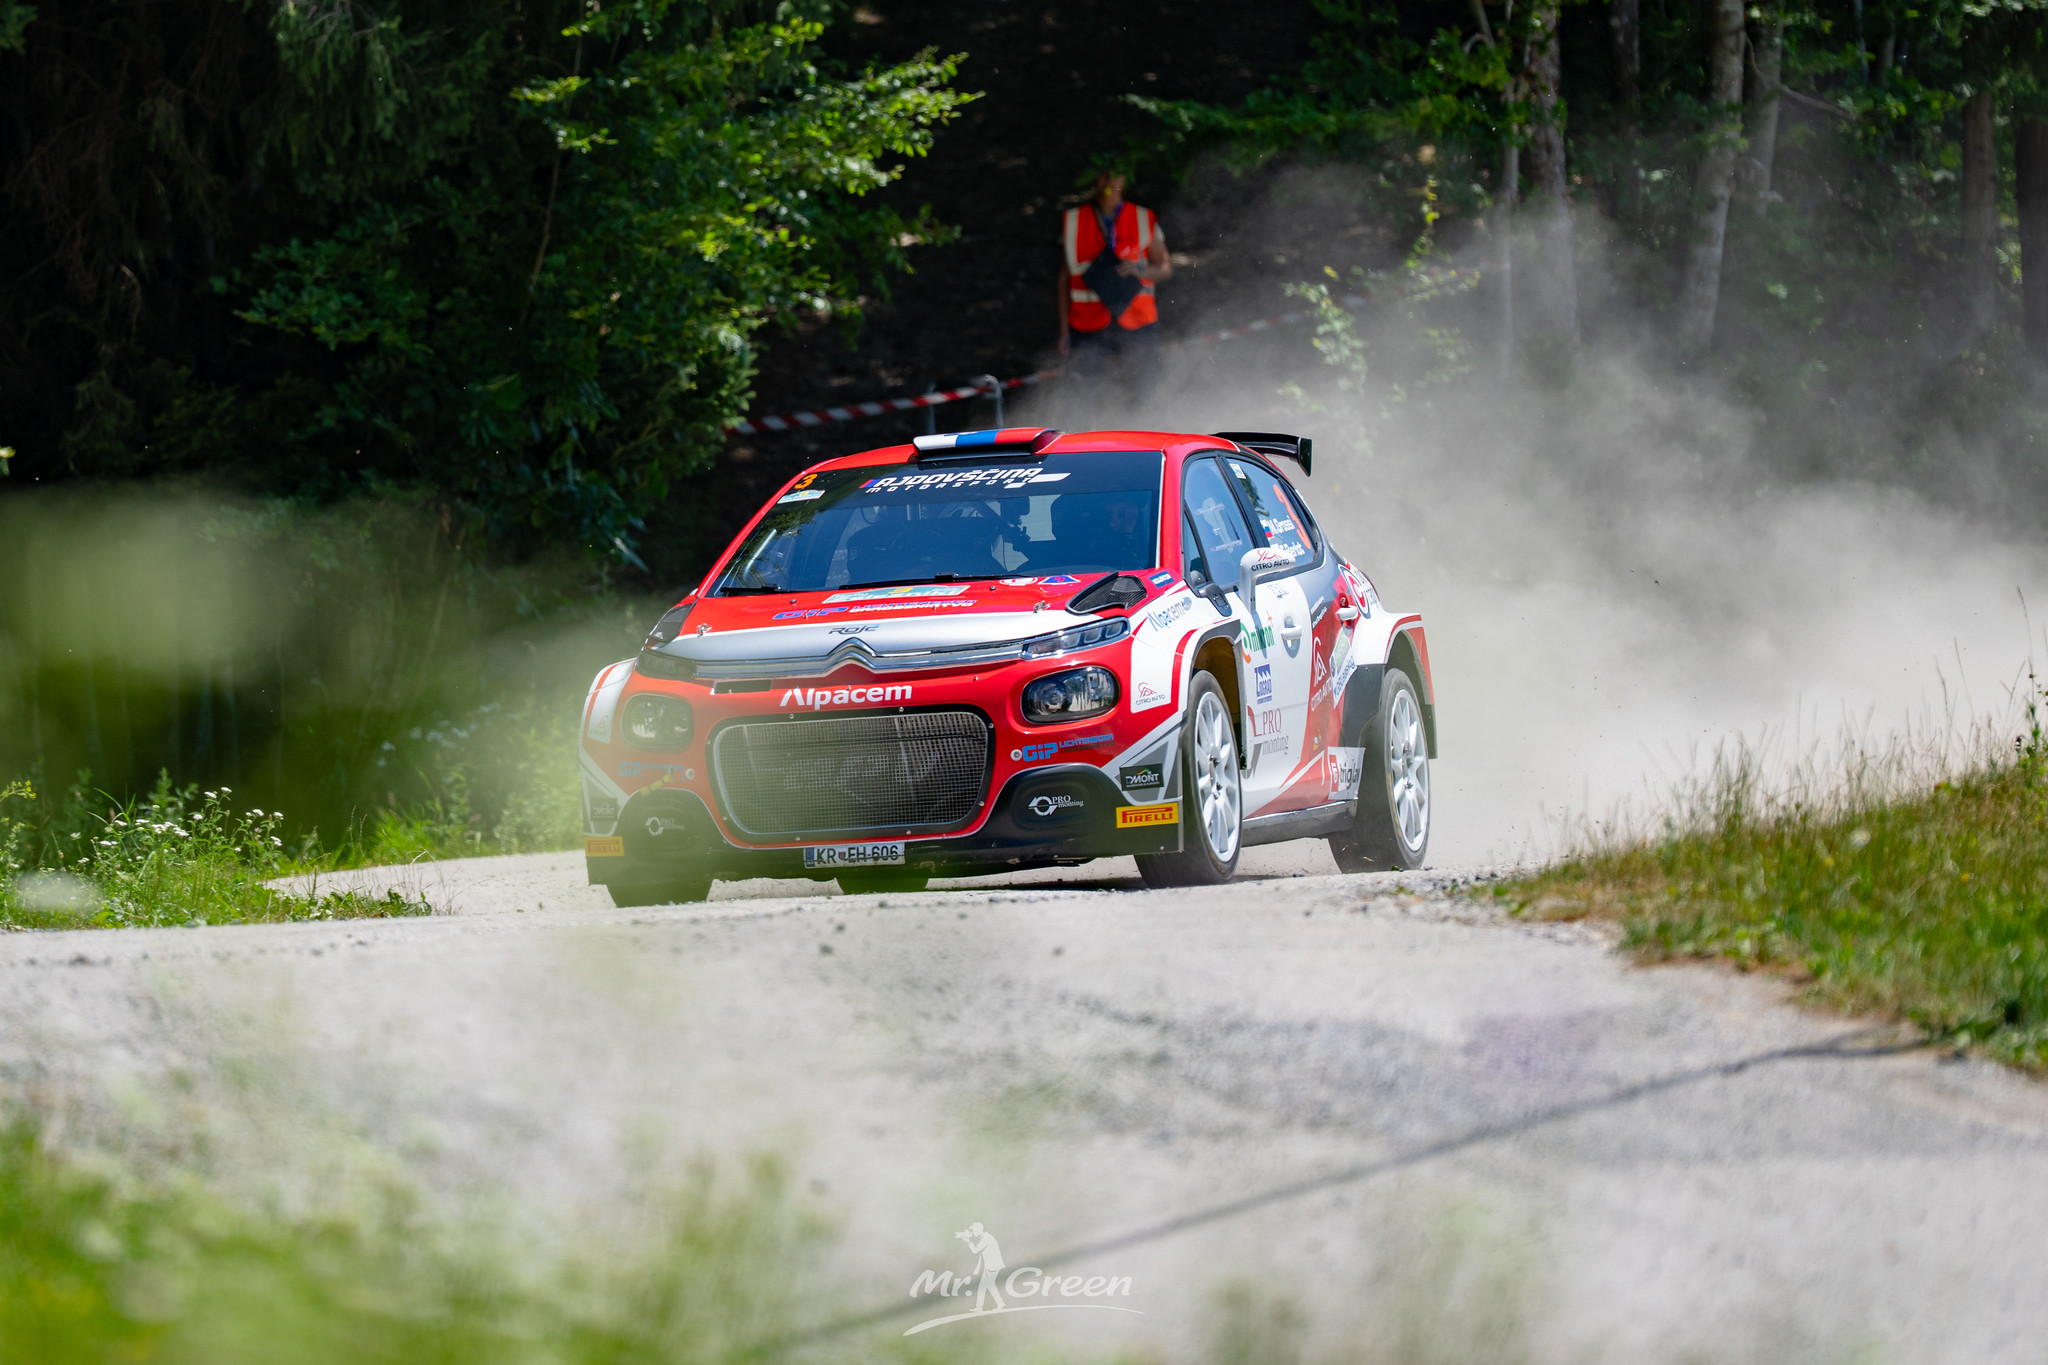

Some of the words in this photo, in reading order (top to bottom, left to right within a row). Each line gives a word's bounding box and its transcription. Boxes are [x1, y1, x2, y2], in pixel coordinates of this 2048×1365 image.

[794, 473, 818, 490] 3
[865, 477, 1034, 494] MOTORSPORT
[1251, 561, 1273, 572] CITRO
[1273, 558, 1290, 567] AVTO
[779, 684, 913, 711] Alpacem
[1262, 708, 1282, 736] PRO
[1340, 761, 1361, 790] triglav
[1052, 795, 1071, 804] PRO
[1121, 807, 1173, 824] PIRELLI
[587, 839, 621, 854] PIRELLI
[816, 847, 837, 865] KR
